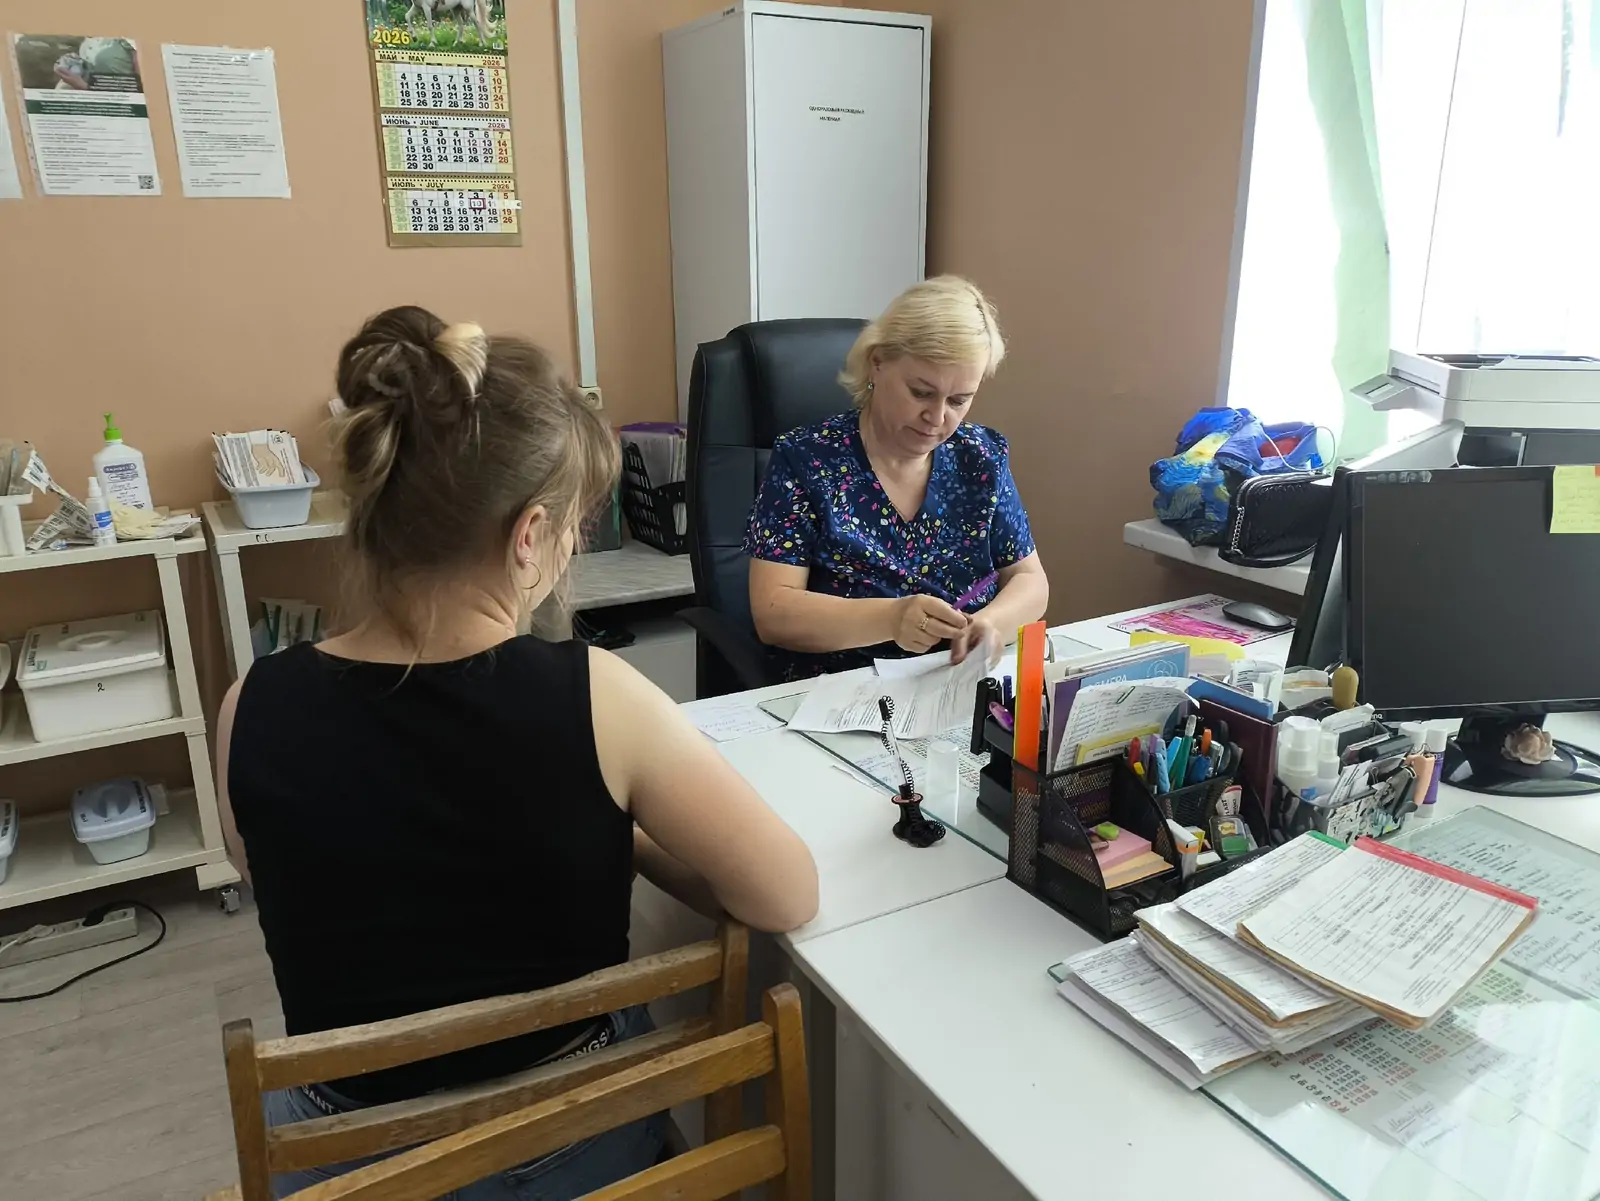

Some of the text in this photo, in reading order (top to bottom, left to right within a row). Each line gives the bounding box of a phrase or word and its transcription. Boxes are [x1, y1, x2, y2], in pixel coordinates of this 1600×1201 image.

[374, 29, 410, 44] 2026
[484, 131, 490, 139] 6
[412, 199, 418, 207] 6
[97, 682, 105, 692] 2
